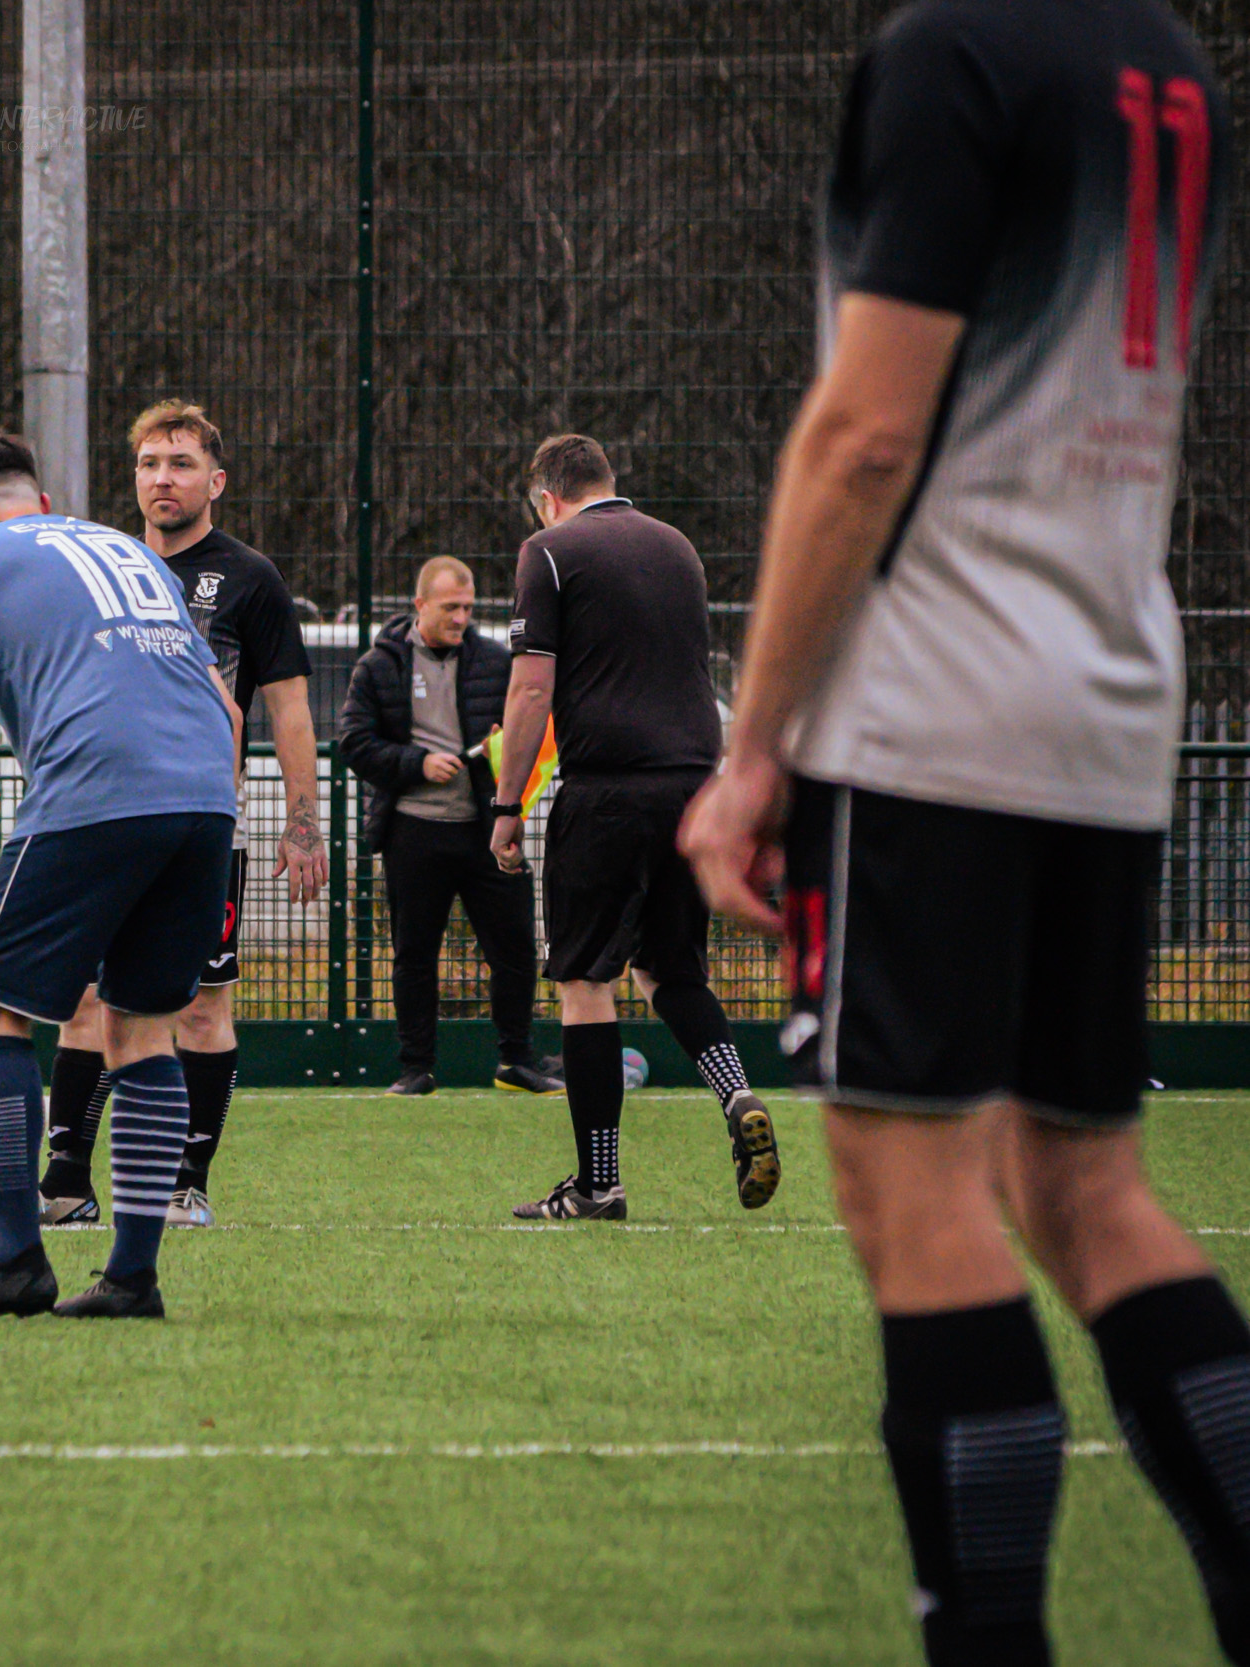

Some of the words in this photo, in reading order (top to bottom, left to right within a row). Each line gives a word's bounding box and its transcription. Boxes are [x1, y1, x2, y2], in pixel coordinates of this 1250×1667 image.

[36, 531, 180, 621] 18
[116, 624, 140, 639] W2
[139, 627, 192, 645] WINDOW
